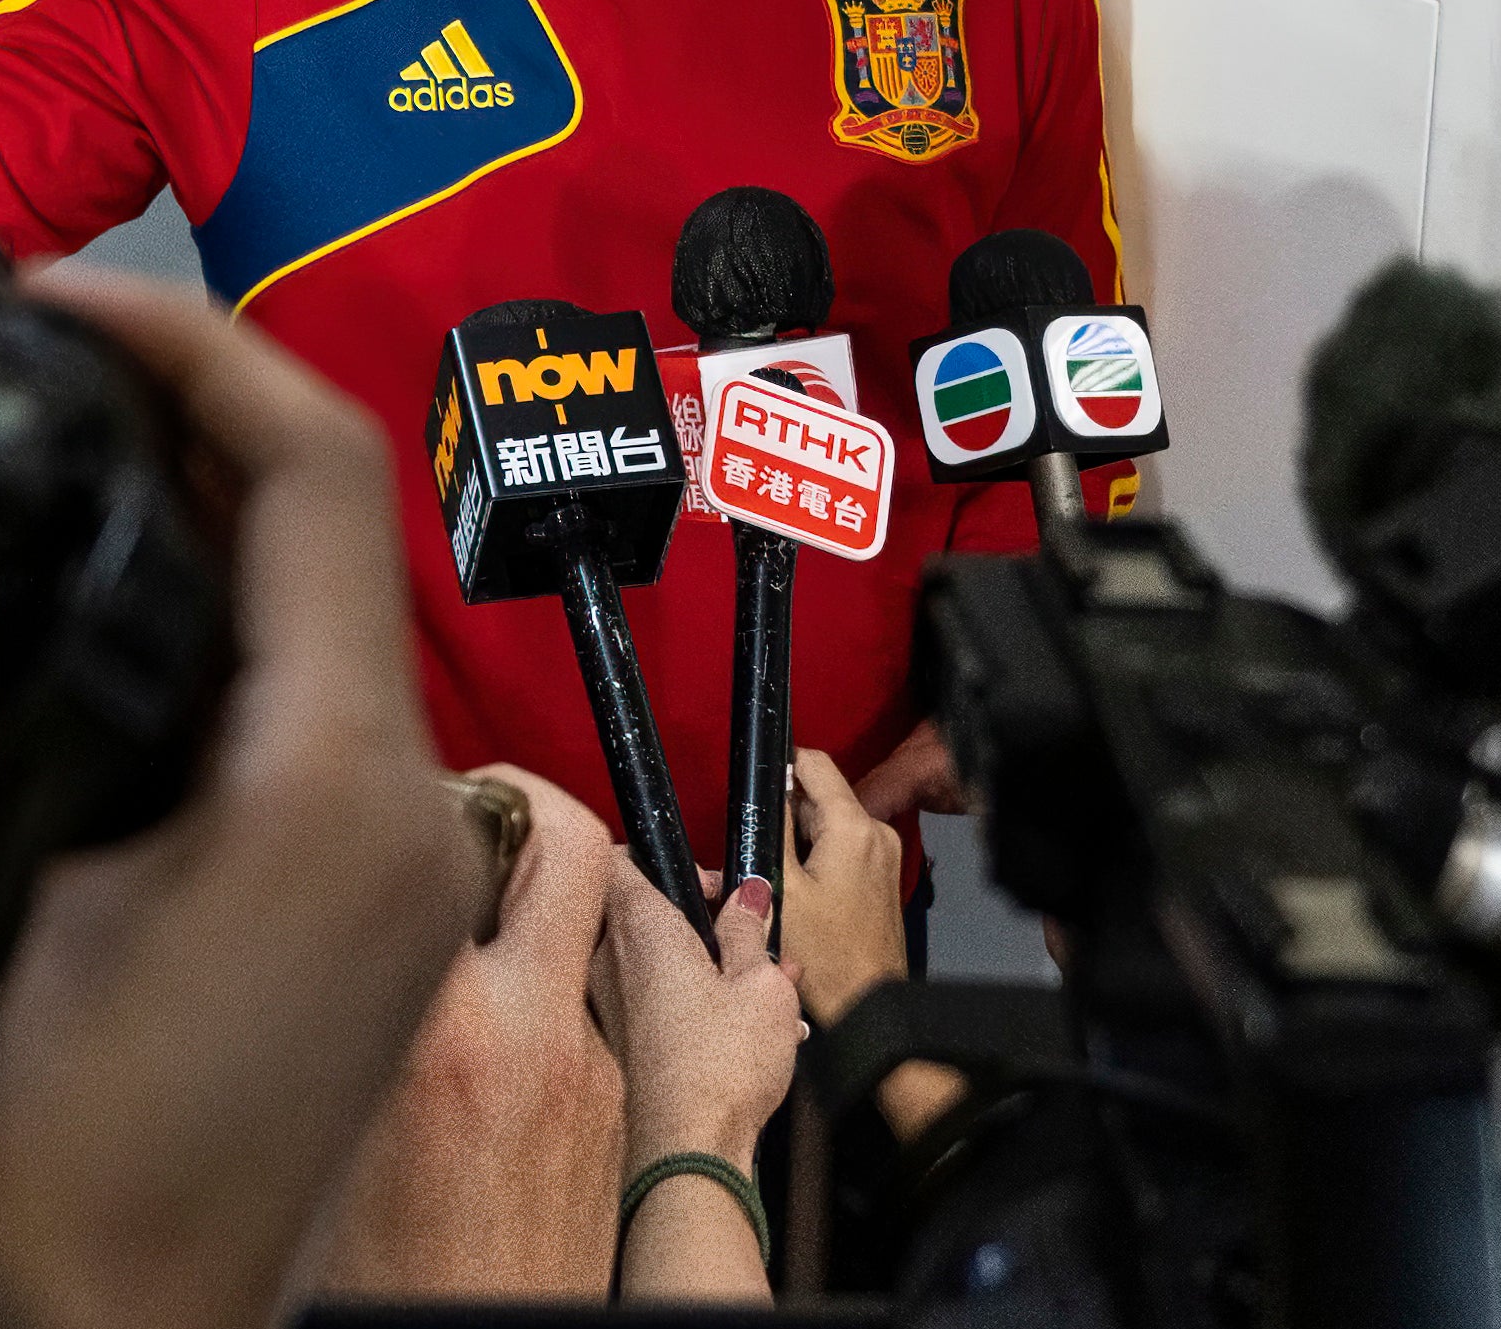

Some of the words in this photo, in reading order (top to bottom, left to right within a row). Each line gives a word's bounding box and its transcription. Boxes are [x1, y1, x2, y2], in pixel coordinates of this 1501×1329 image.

[388, 76, 515, 112] adidas
[476, 347, 637, 407] now
[496, 425, 667, 487] 新聞台
[734, 400, 871, 474] RTHK
[721, 452, 868, 534] 香港電台
